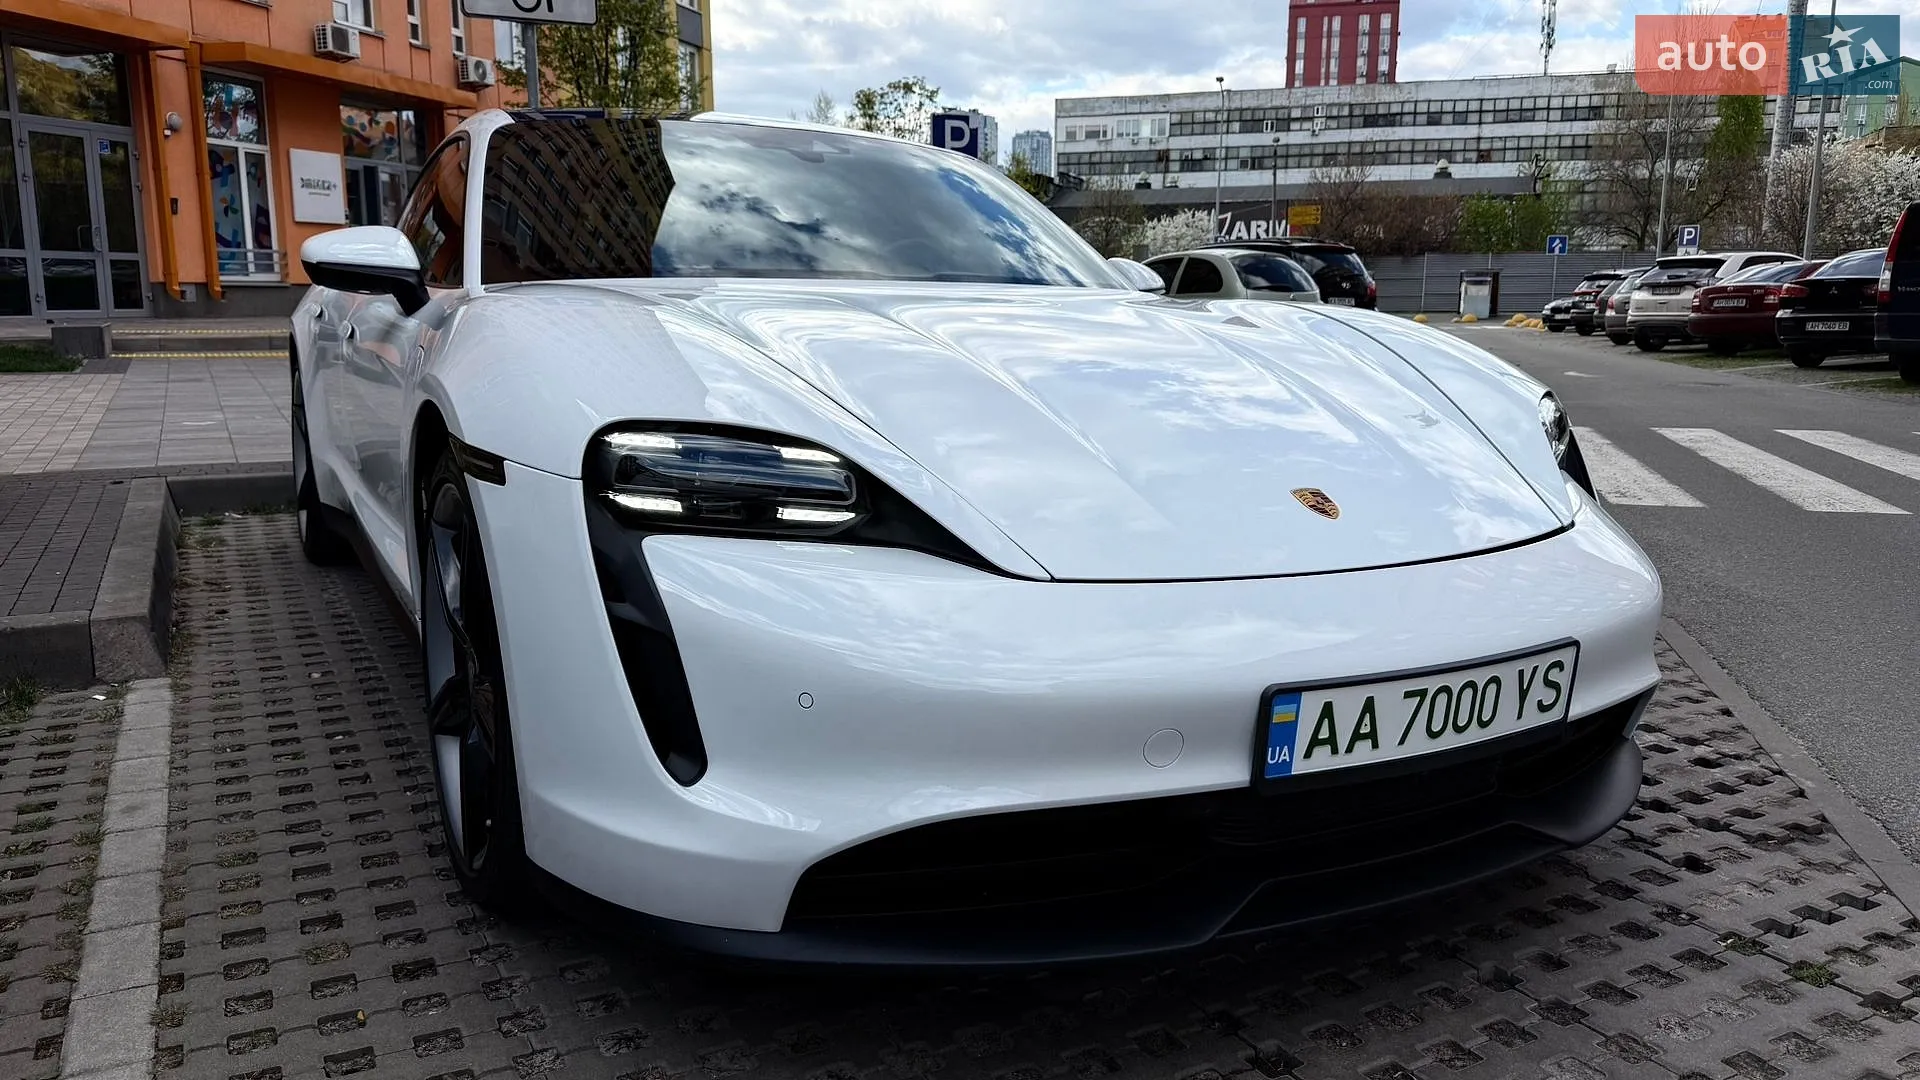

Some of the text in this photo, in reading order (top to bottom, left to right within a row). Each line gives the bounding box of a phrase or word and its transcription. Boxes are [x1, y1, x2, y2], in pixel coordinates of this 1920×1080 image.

[944, 119, 971, 150] P
[1682, 227, 1696, 245] P
[1302, 659, 1566, 759] AA 7000 YS
[1266, 745, 1290, 764] UA
